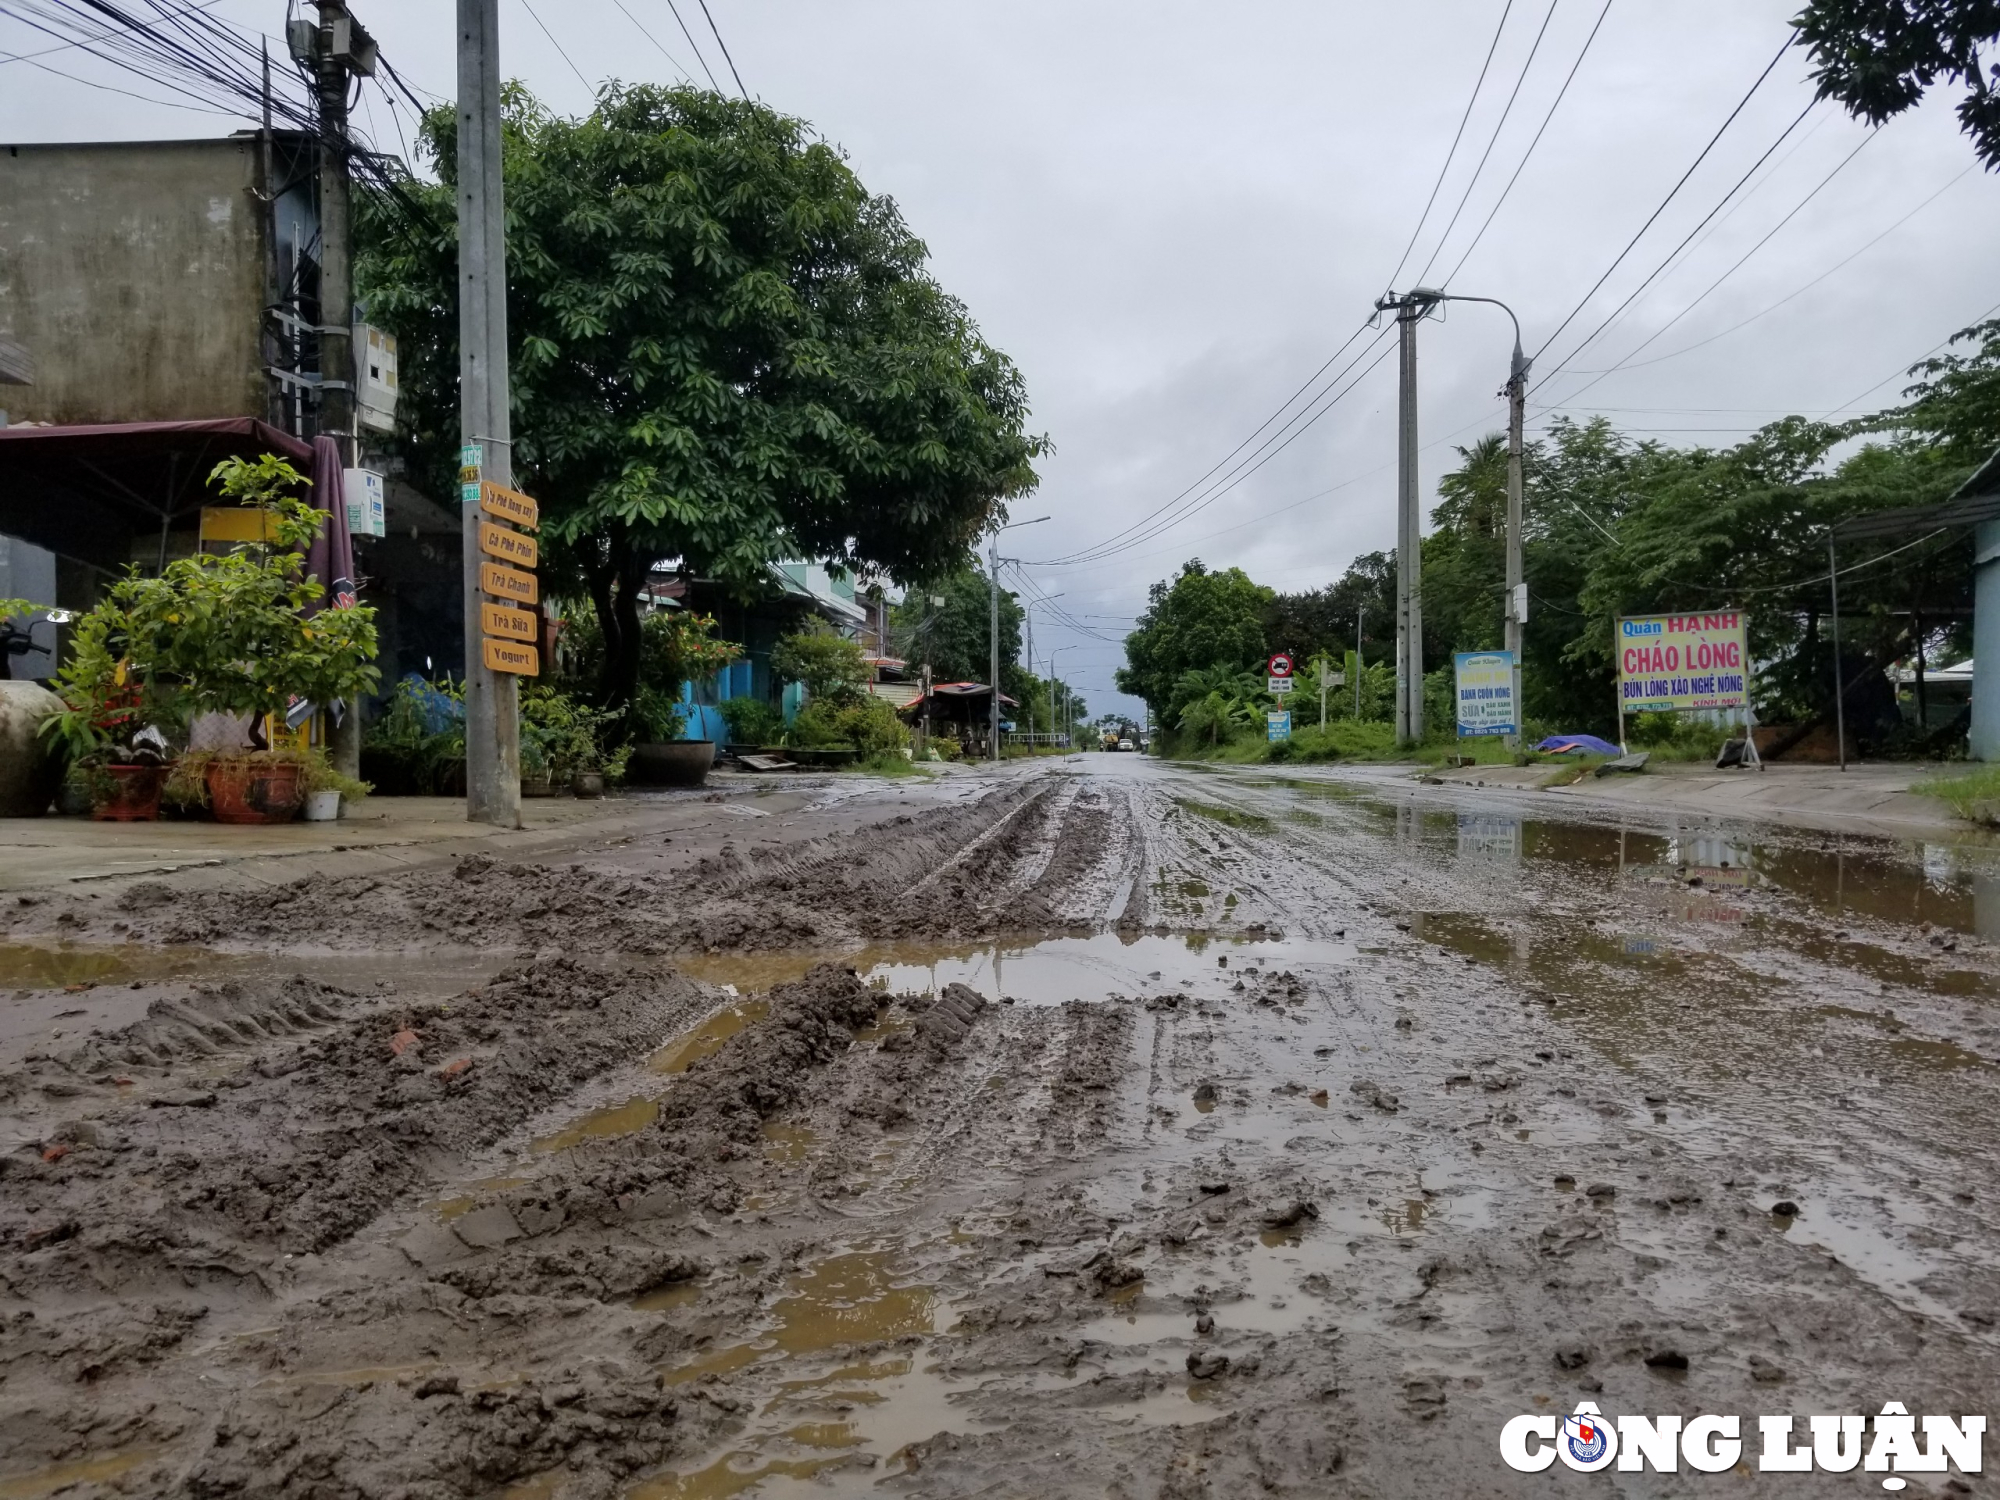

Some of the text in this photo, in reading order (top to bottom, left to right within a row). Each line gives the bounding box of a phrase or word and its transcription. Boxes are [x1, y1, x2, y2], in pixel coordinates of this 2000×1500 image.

[496, 493, 507, 508] Phê
[522, 505, 533, 519] xay
[488, 532, 499, 547] Cà
[500, 538, 515, 552] Phê
[491, 572, 531, 595] Trà Chanh
[492, 613, 529, 633] Trà Sữa
[1622, 613, 1738, 637] Quán HẠNH
[494, 647, 530, 665] Yogurt
[1623, 637, 1740, 674] CHÁO LÒNG
[1624, 672, 1743, 699] BÚN LÒNG XÀO NGHỆ NÓNG
[1462, 704, 1480, 717] SỮA
